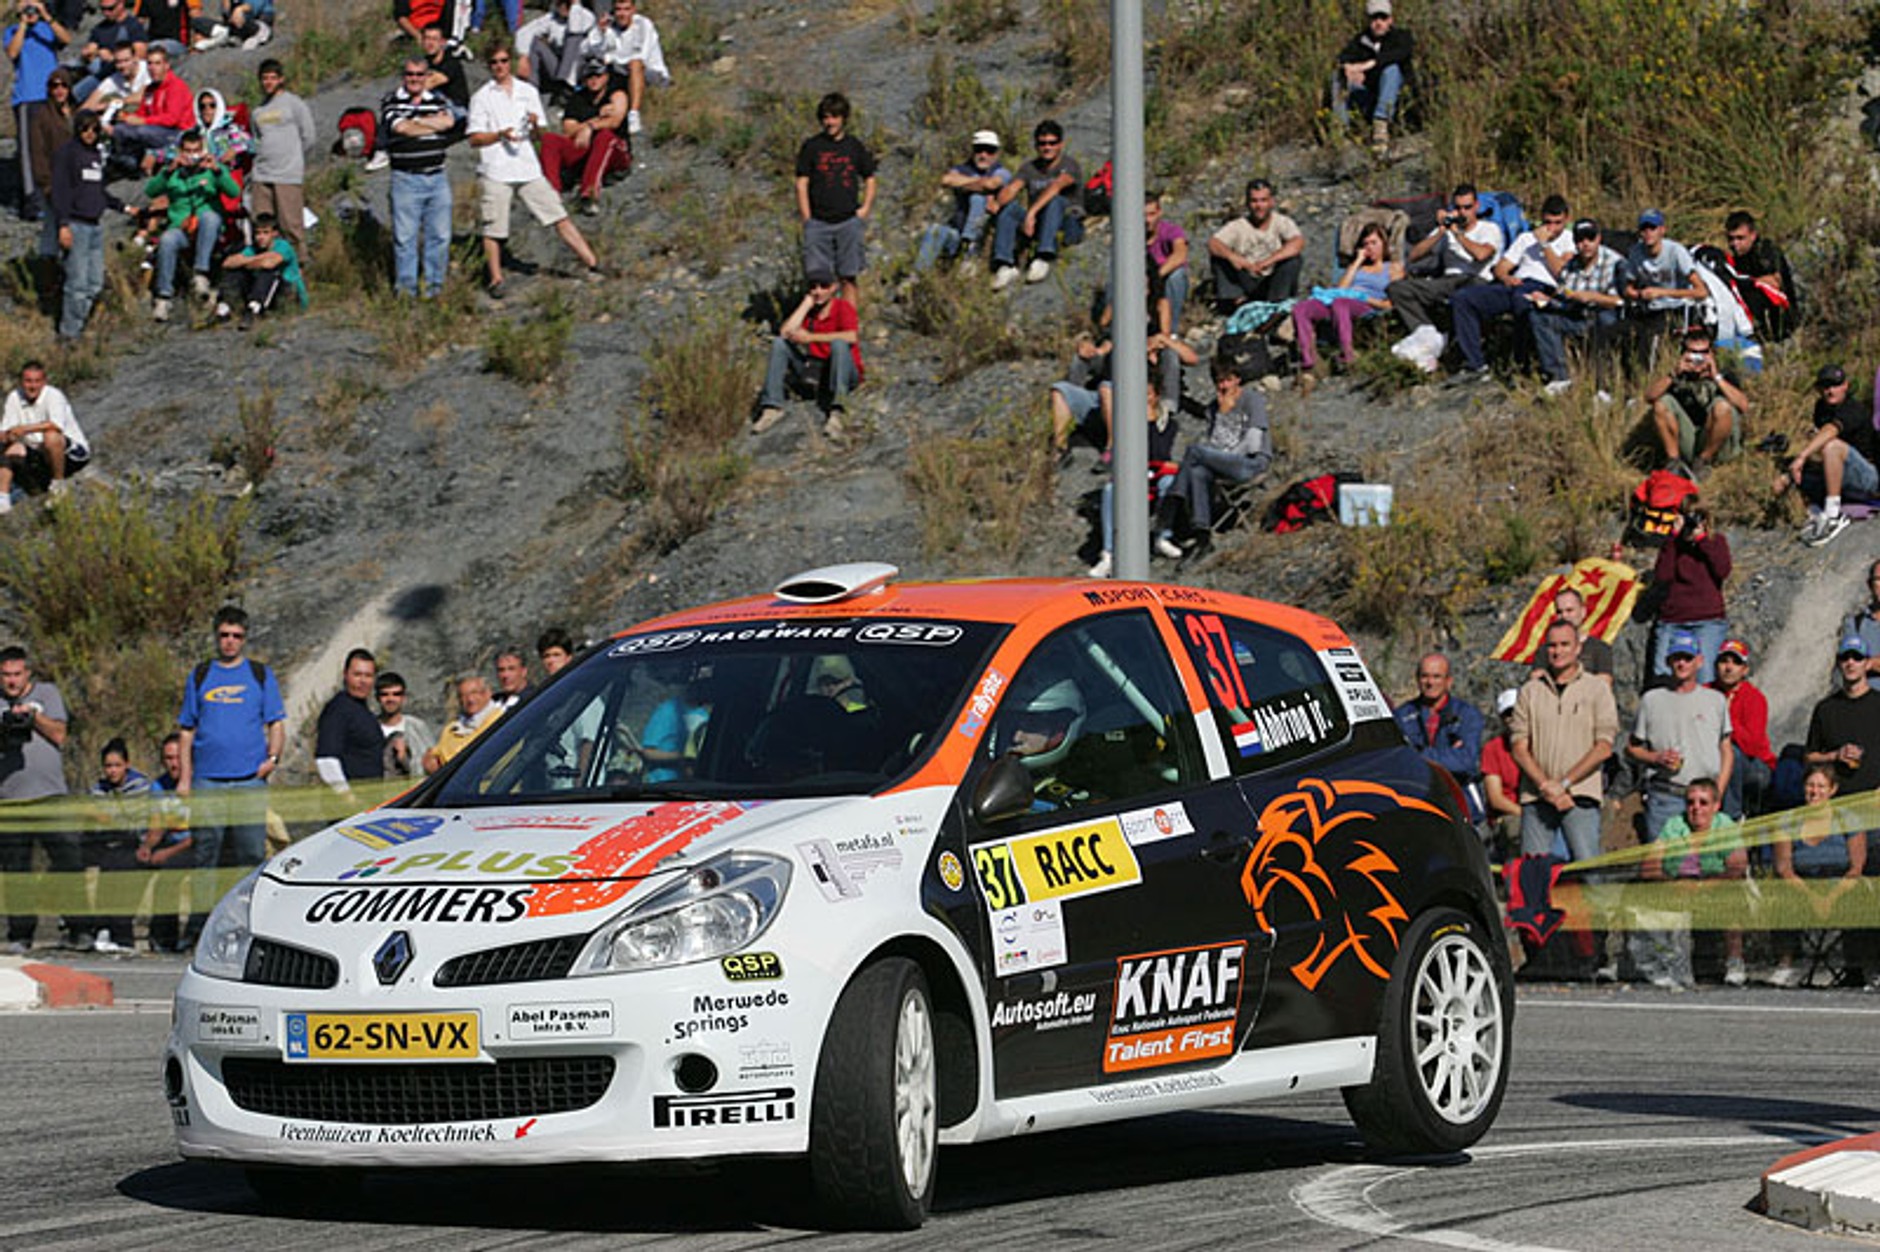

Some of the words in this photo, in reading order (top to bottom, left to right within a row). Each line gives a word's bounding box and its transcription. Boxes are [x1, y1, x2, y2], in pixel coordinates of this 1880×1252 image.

[618, 631, 695, 655] QSP
[700, 627, 852, 643] RACEWARE
[863, 623, 958, 641] QSP
[1184, 614, 1251, 711] 37
[389, 850, 581, 877] PLUS
[976, 847, 1019, 909] 37
[1034, 834, 1115, 888] RACC
[306, 887, 534, 924] GOMMERS
[723, 954, 776, 973] QSP
[1116, 946, 1244, 1019] KNAF
[511, 1011, 546, 1024] Abel
[548, 1009, 611, 1023] Pasman
[693, 989, 790, 1014] Merwede
[991, 991, 1097, 1028] Autosoft.eu
[314, 1021, 470, 1051] 62-SN-VX
[674, 1014, 749, 1040] Springs
[1109, 1035, 1175, 1063] Talent
[1180, 1025, 1232, 1052] First
[653, 1087, 795, 1129] PIRELLI
[279, 1121, 373, 1142] Veenhuizen
[378, 1122, 497, 1143] Koeltechniek
